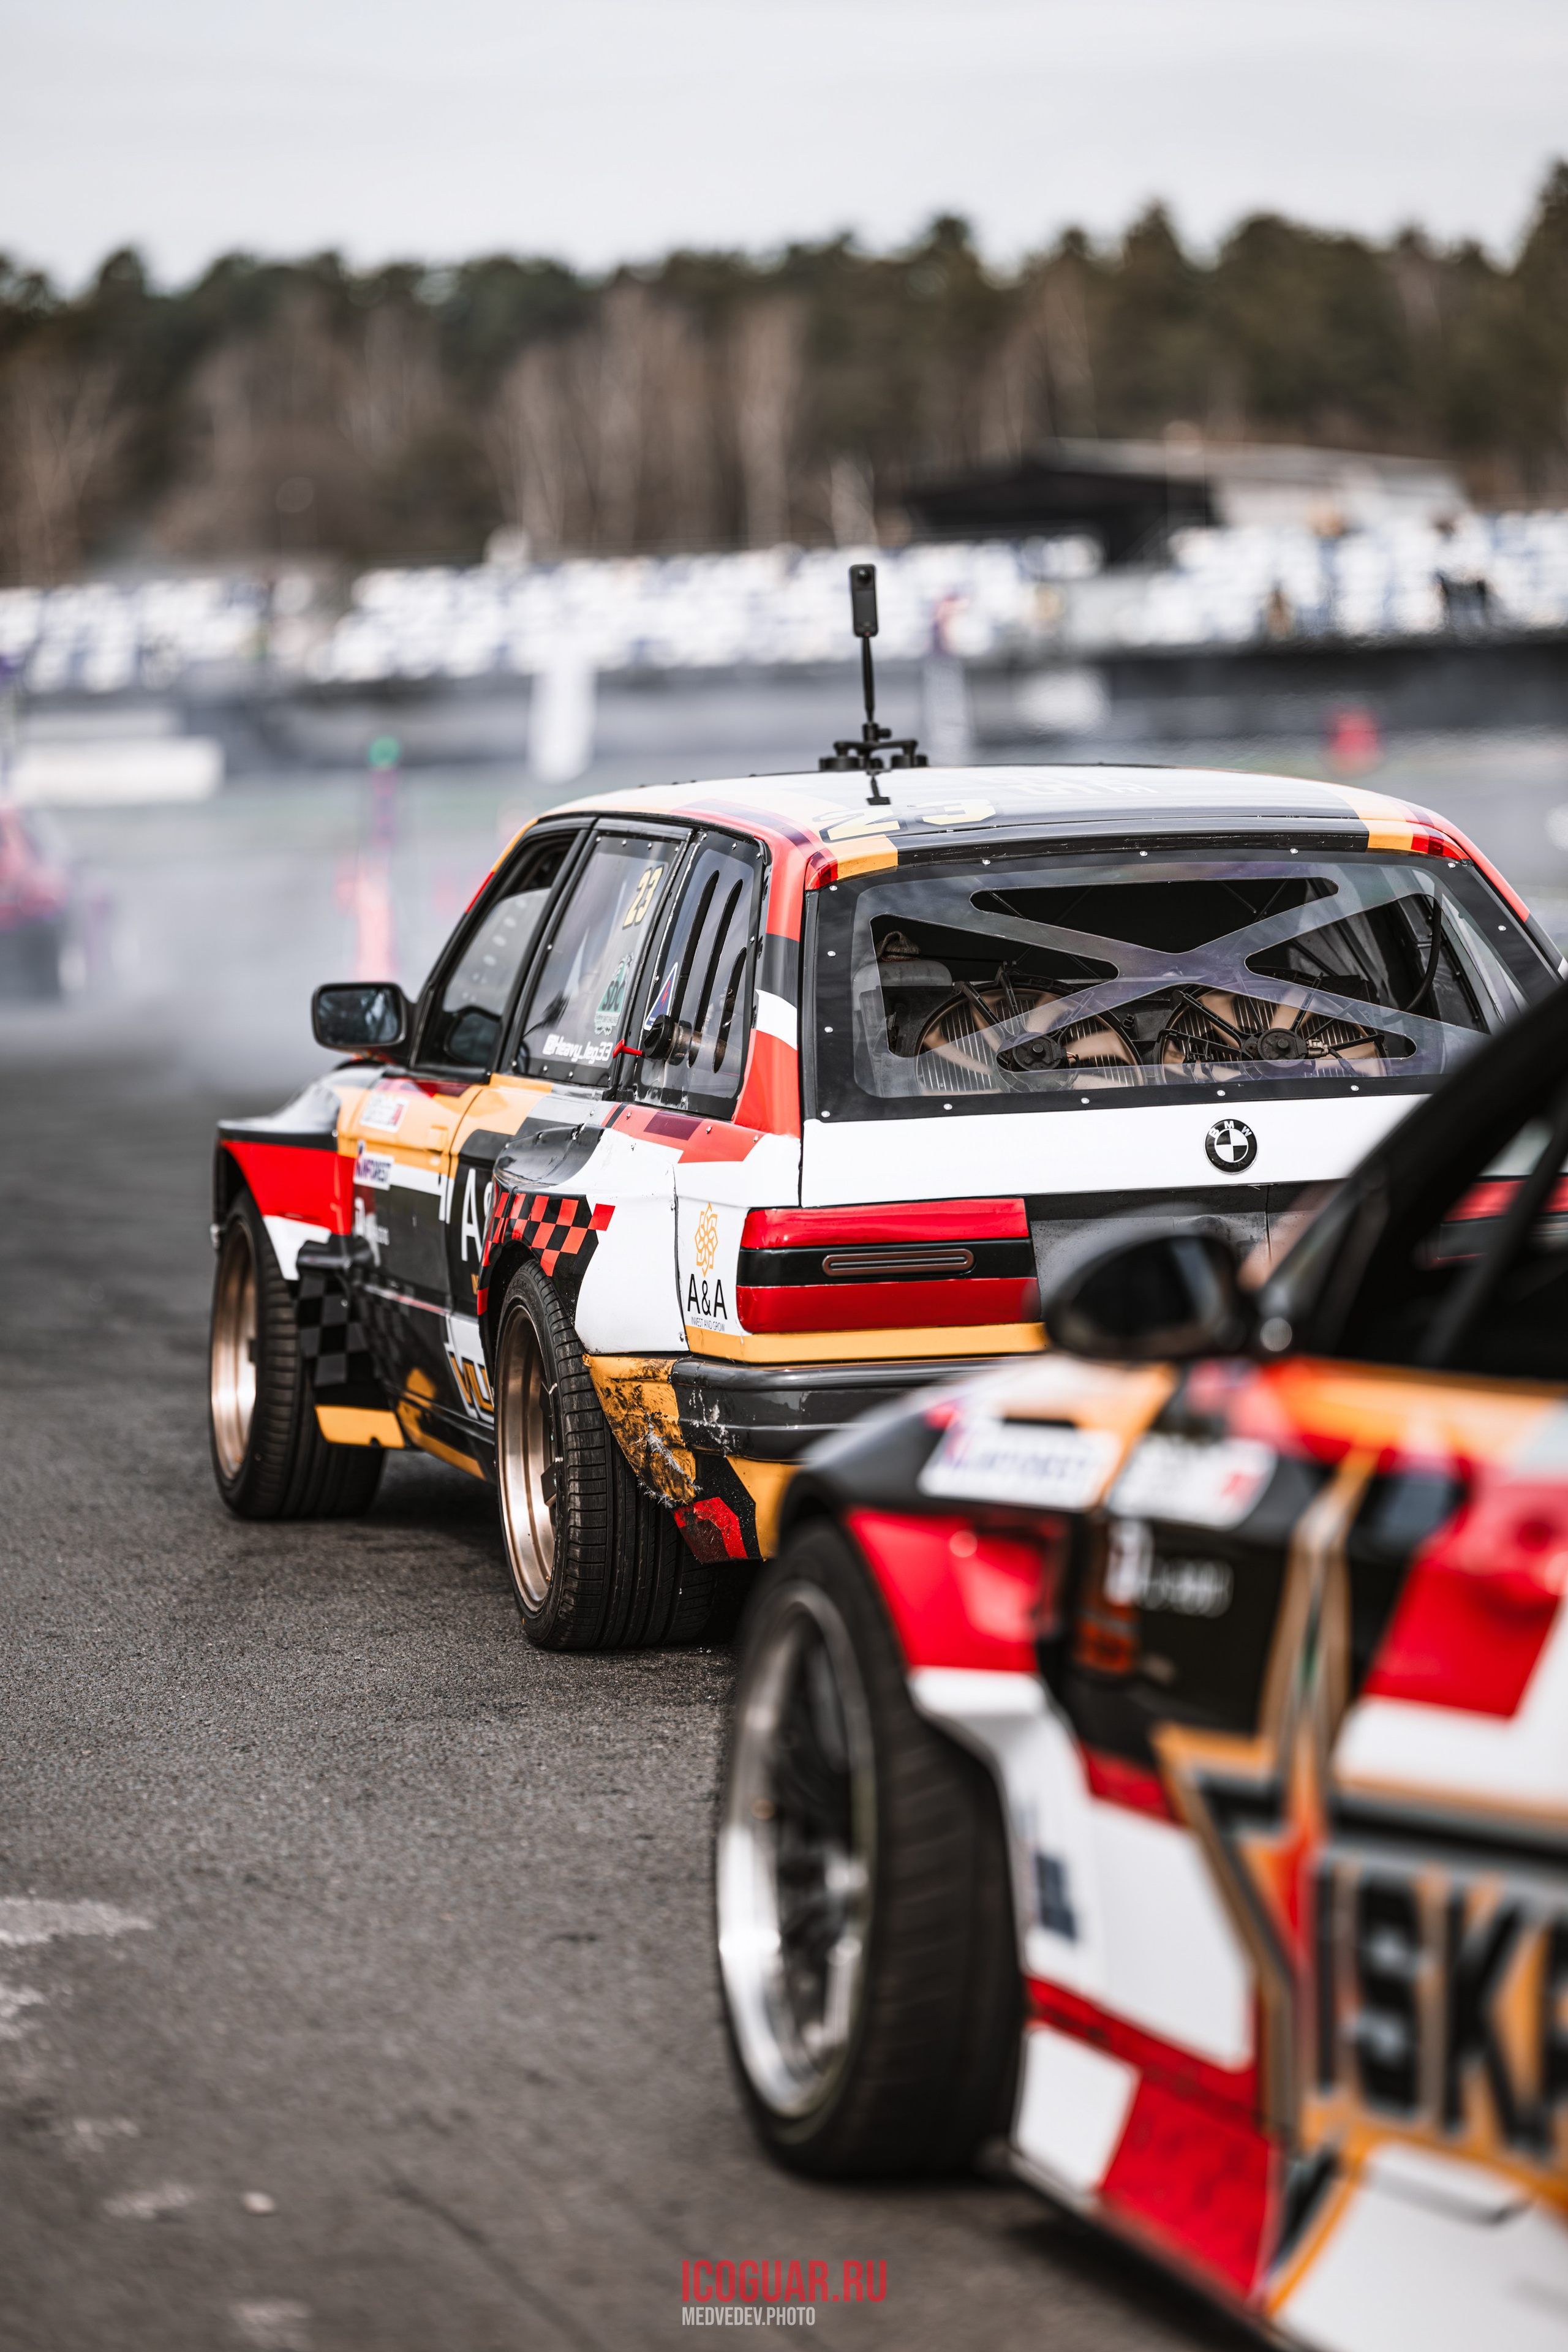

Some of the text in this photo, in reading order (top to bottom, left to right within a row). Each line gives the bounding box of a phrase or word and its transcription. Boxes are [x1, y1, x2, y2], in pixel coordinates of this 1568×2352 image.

[812, 798, 1001, 843] 23
[622, 864, 664, 930] 23
[601, 980, 625, 1011] SDC
[1208, 1120, 1252, 1139] BMW
[687, 1273, 728, 1320] A&A
[691, 1316, 725, 1332] INVEST AND GROW
